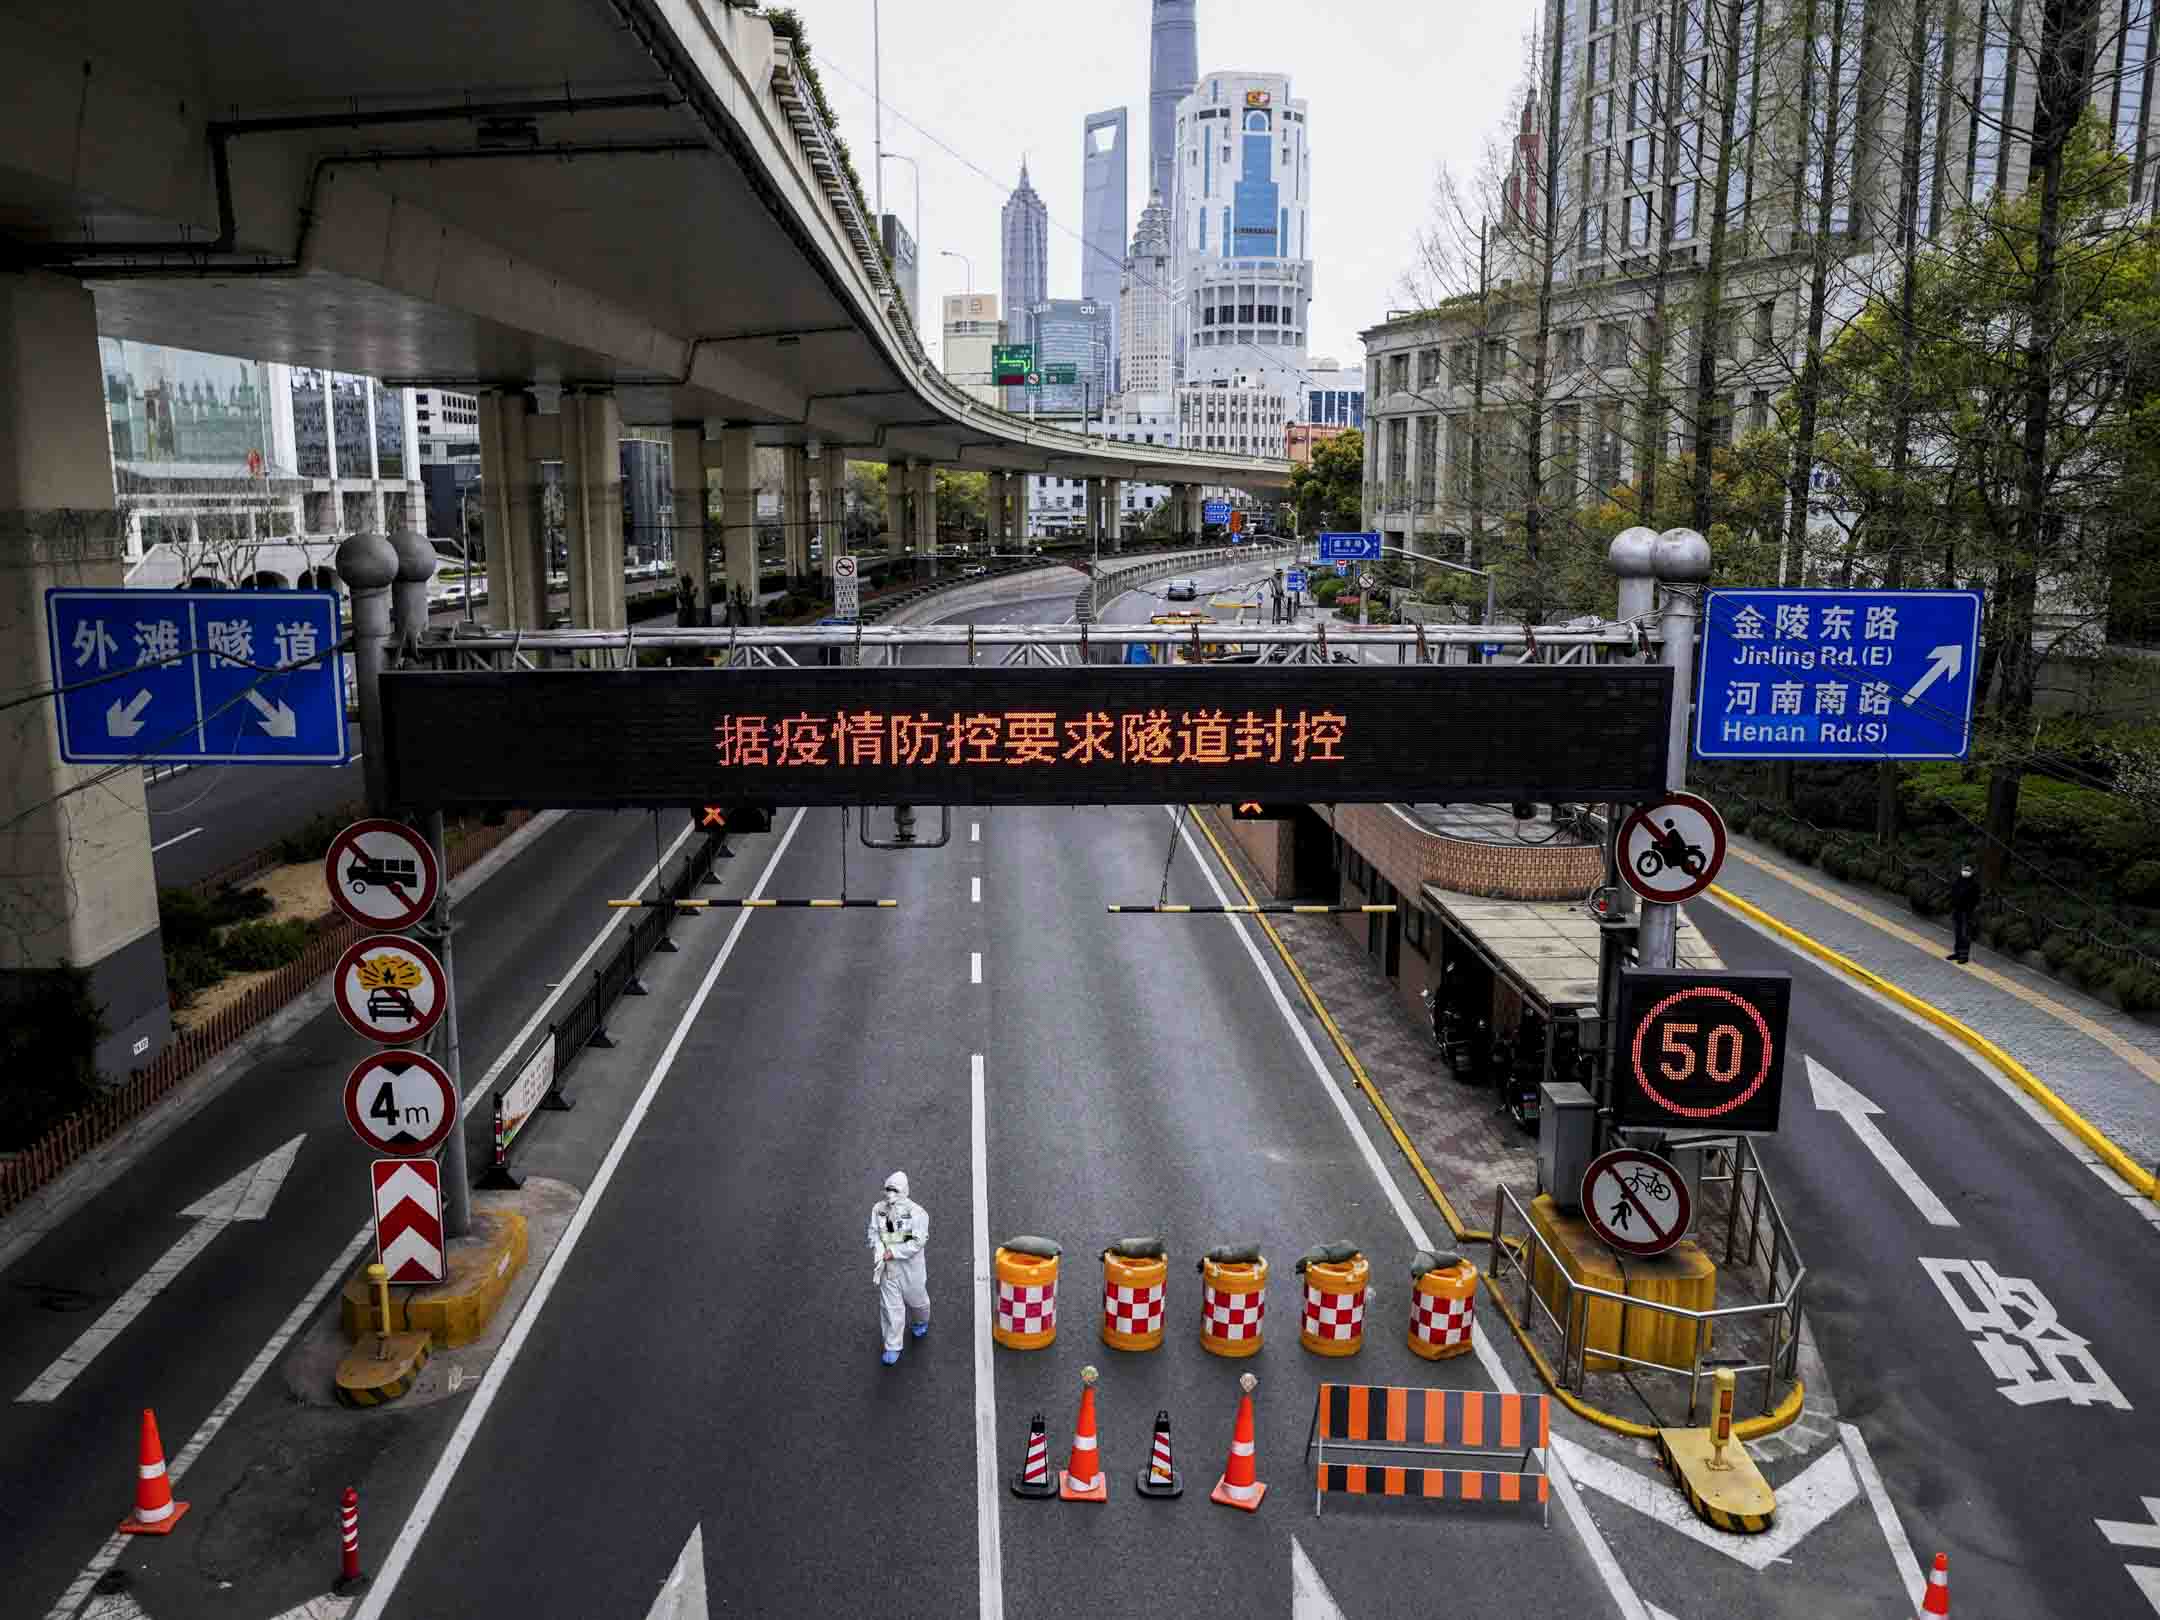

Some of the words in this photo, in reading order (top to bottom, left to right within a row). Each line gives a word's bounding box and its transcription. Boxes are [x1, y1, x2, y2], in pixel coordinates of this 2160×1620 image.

[1732, 604, 1899, 640] 金陵东路
[72, 619, 322, 670] 外滩隧道
[1734, 646, 1816, 669] Jinling
[1724, 680, 1891, 716] 河南南路
[714, 709, 1347, 766] 据疫情防控要求隧道封控
[1722, 720, 1805, 742] Henan
[1820, 722, 1888, 744] Rd.(S)
[1661, 1022, 1744, 1083] 50
[1918, 1256, 2134, 1410] 路
